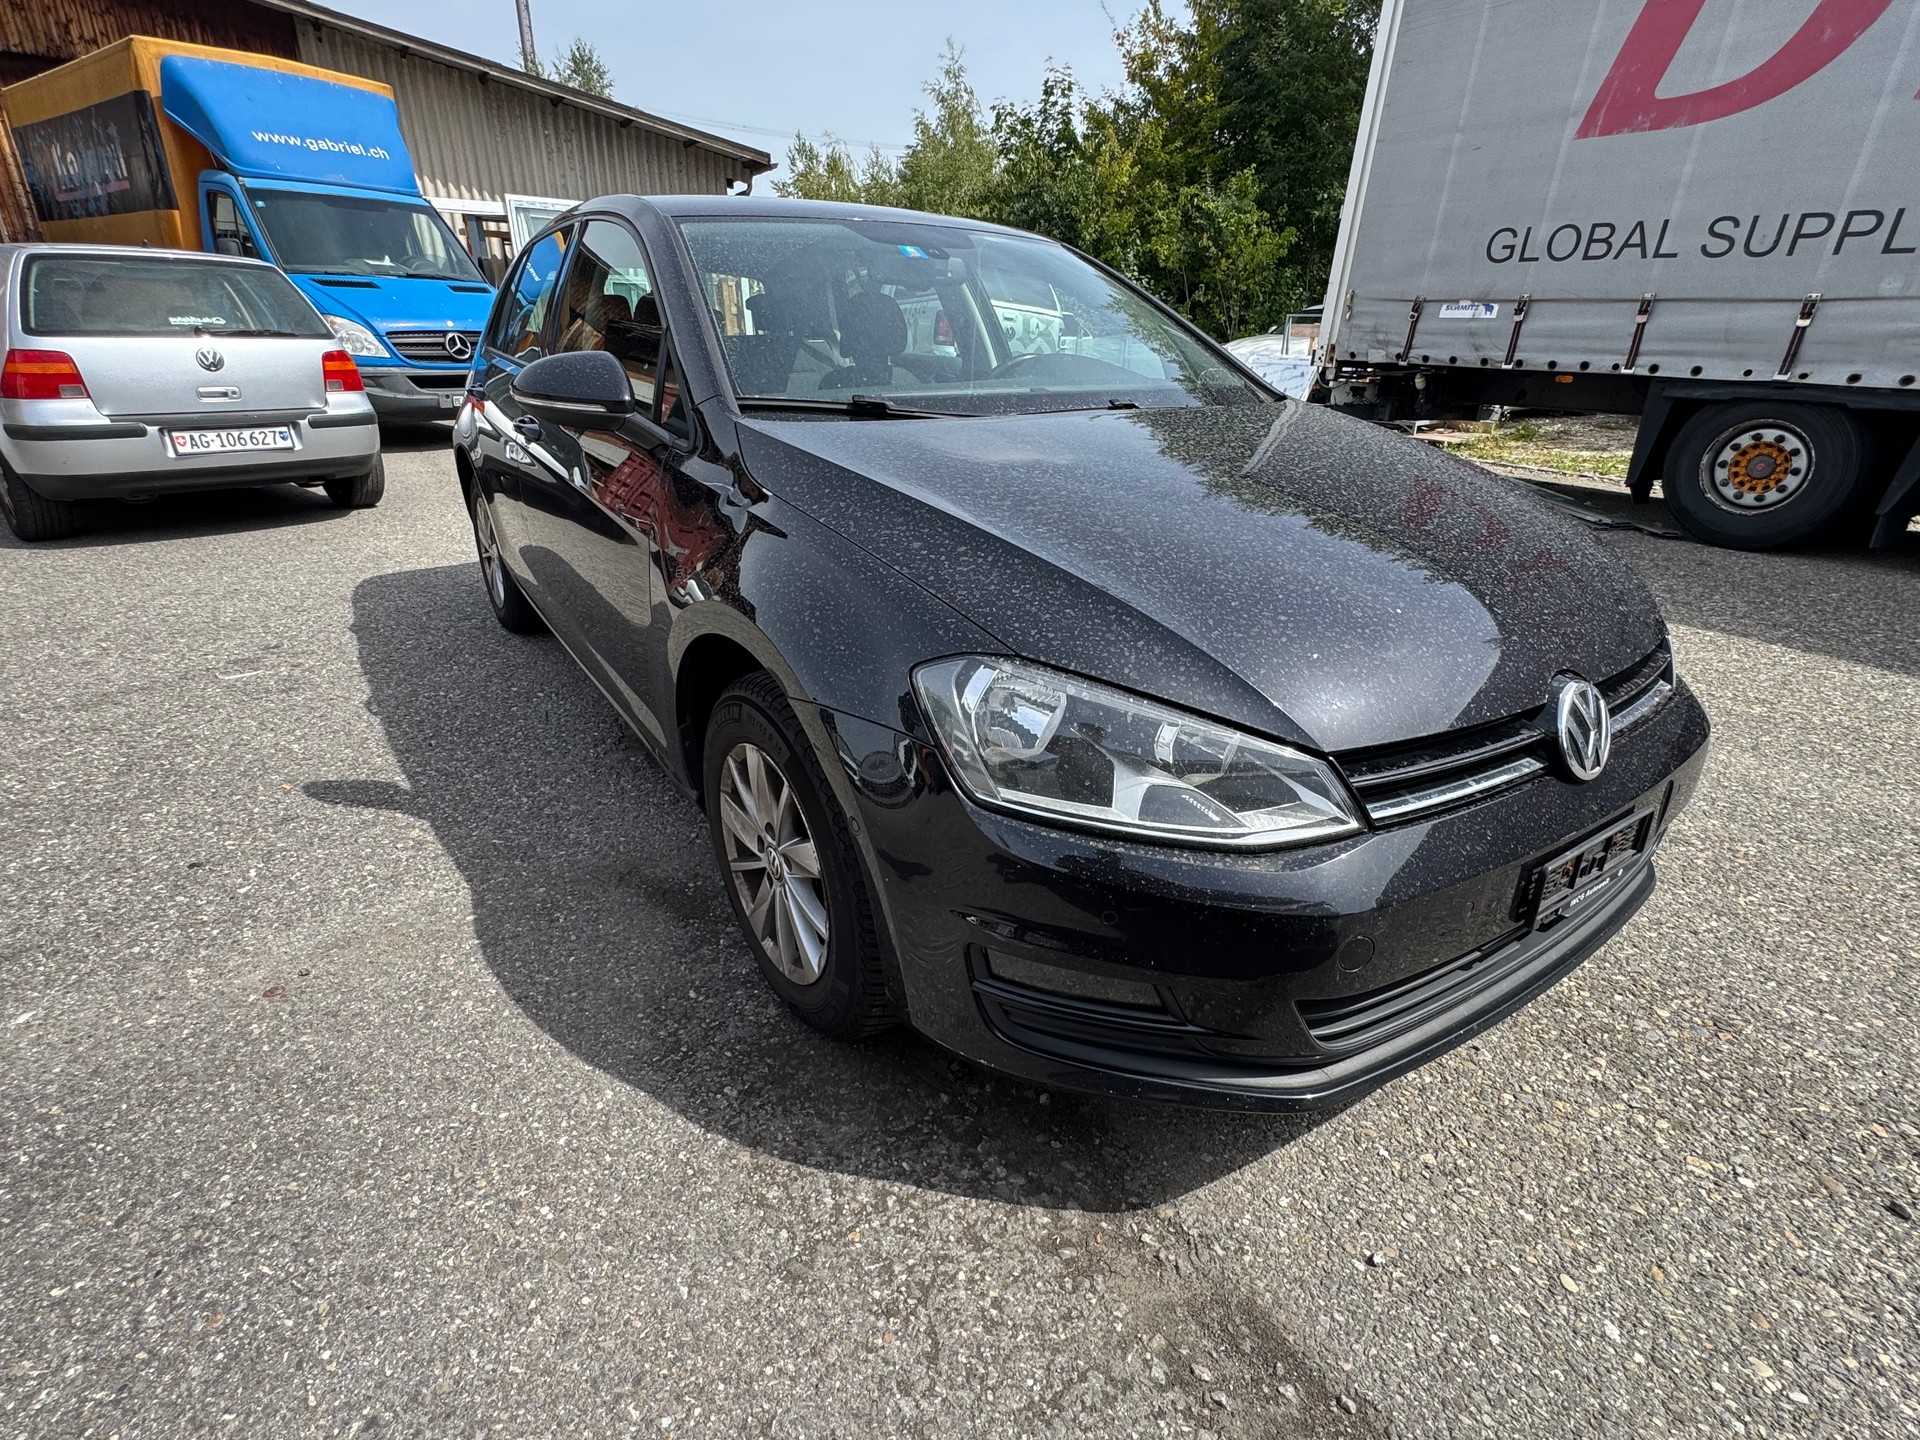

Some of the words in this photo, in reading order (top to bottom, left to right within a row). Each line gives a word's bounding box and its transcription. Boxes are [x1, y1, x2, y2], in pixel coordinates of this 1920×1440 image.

[251, 131, 390, 160] www.gabriel.ch
[1486, 218, 1679, 264] GLOBAL
[1699, 207, 1918, 259] SUPPL
